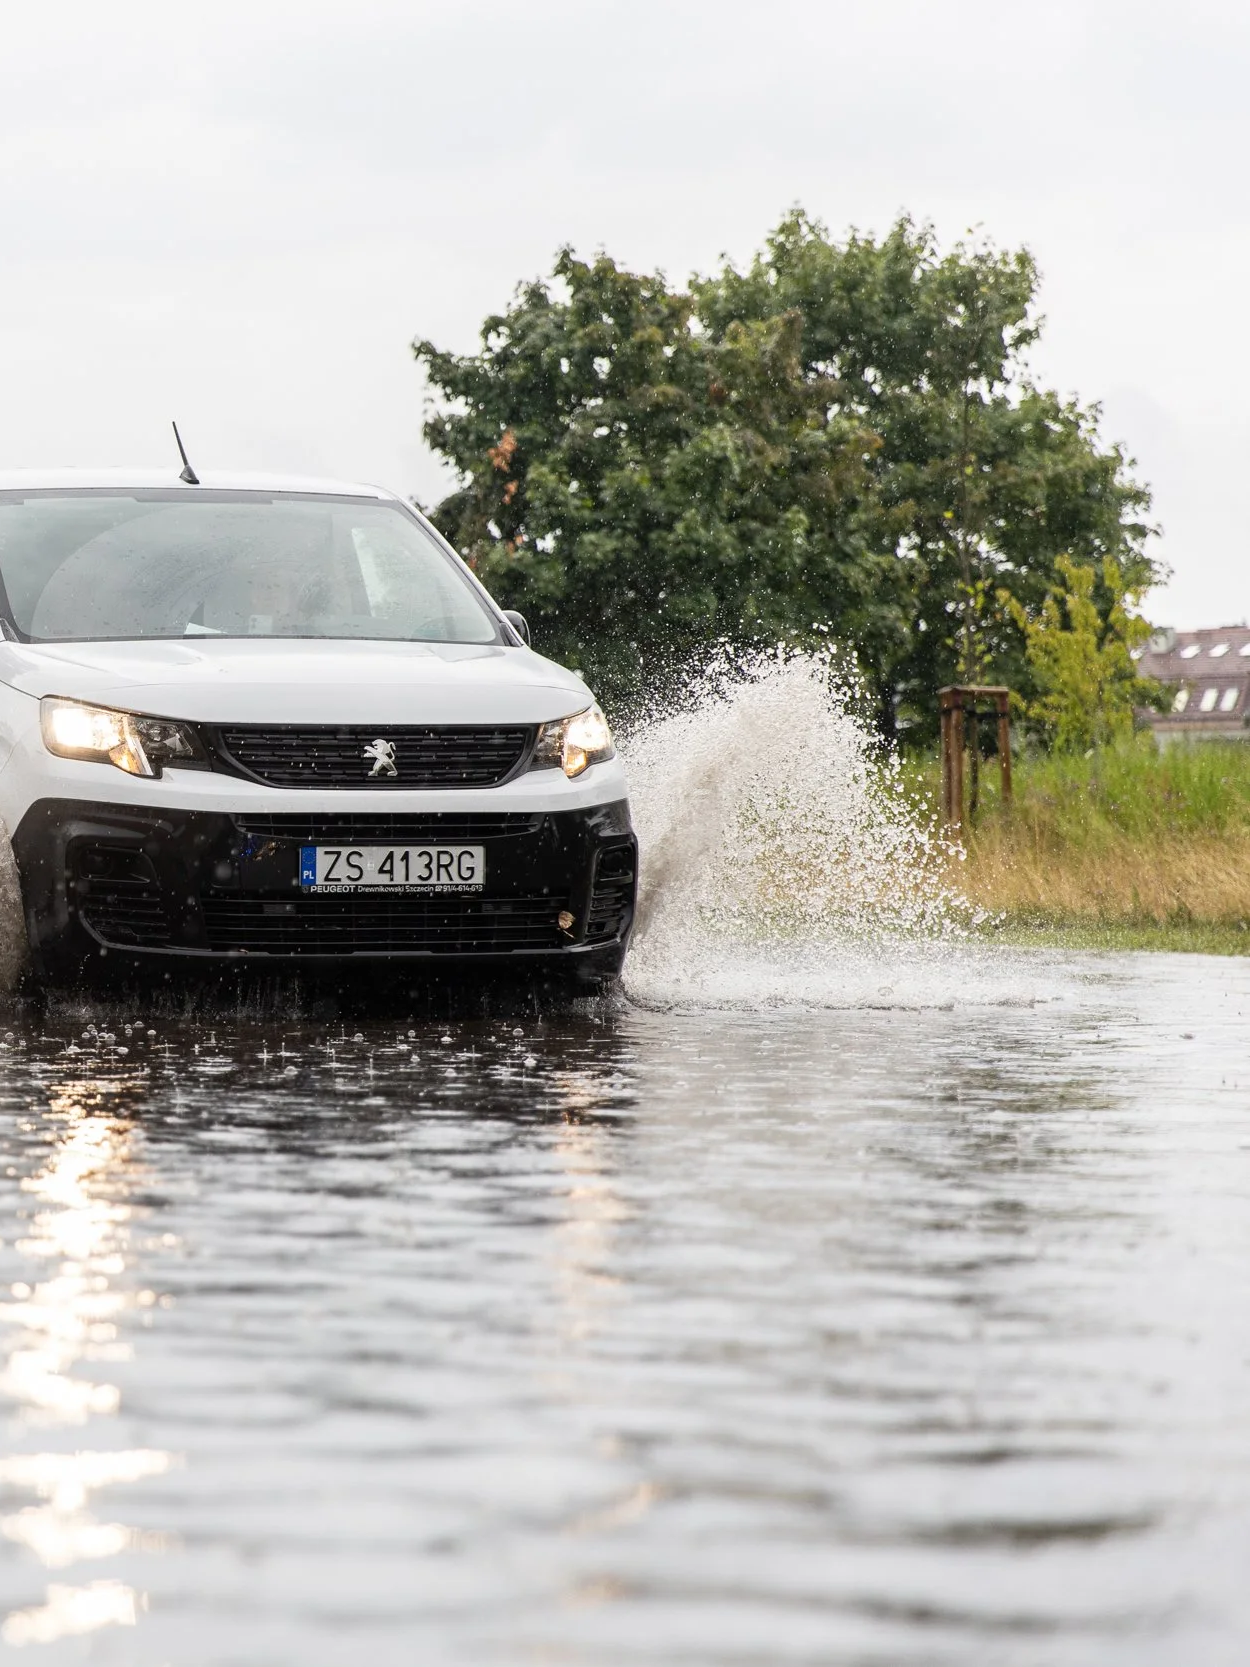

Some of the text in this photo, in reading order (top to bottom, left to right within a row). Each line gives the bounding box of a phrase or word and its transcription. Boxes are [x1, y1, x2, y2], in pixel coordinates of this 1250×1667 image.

[323, 850, 476, 882] ZS 413RG
[303, 870, 314, 880] PL
[310, 885, 356, 893] PEUGEOT
[405, 885, 434, 893] Szczecin
